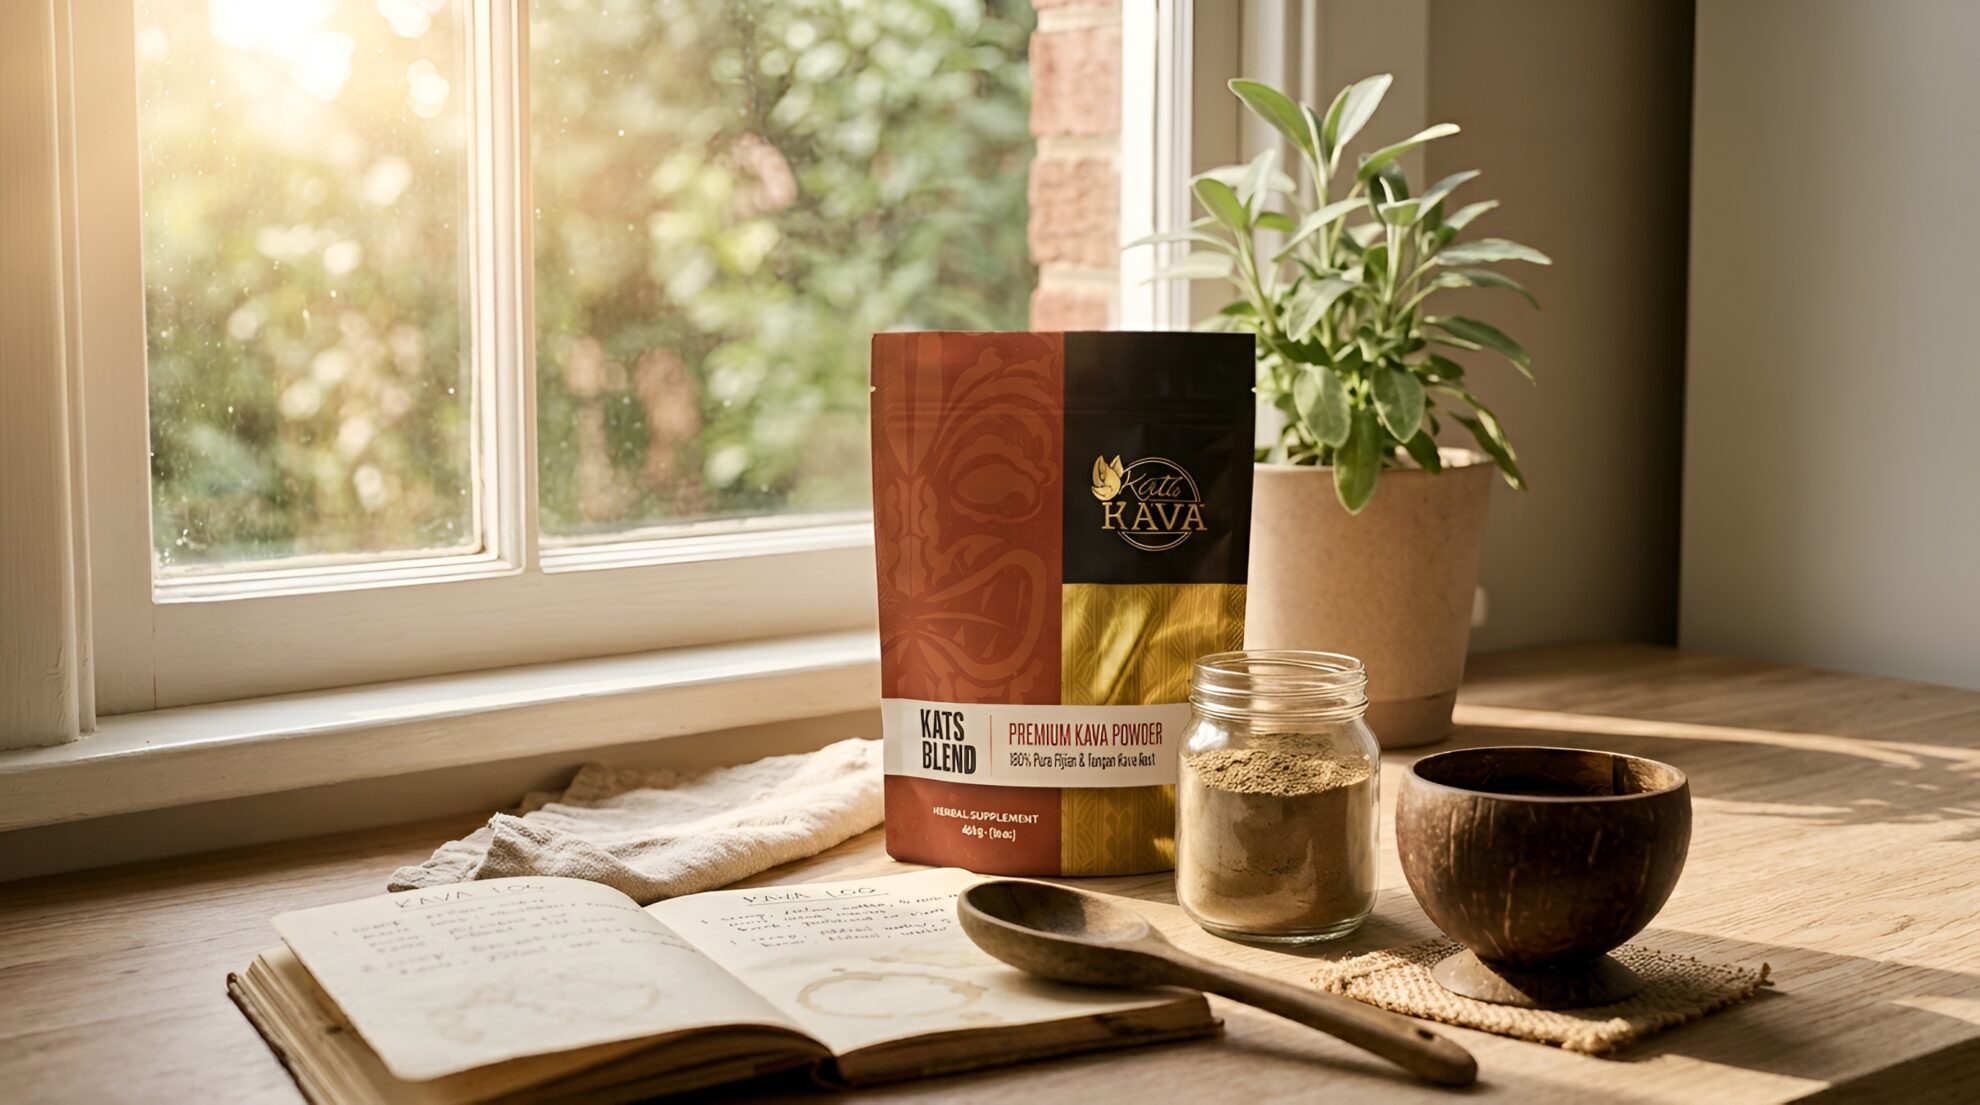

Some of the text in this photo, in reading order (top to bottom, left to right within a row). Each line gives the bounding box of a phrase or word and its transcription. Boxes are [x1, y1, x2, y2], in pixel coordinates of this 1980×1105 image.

[1101, 502, 1208, 531] KAVA
[920, 709, 964, 742] KATS
[1009, 722, 1163, 746] PREMIUM KAVA POWDER
[923, 741, 977, 775] BLEND
[1078, 752, 1086, 768] &
[933, 806, 1039, 824] HERBAL SUPPLEMENT
